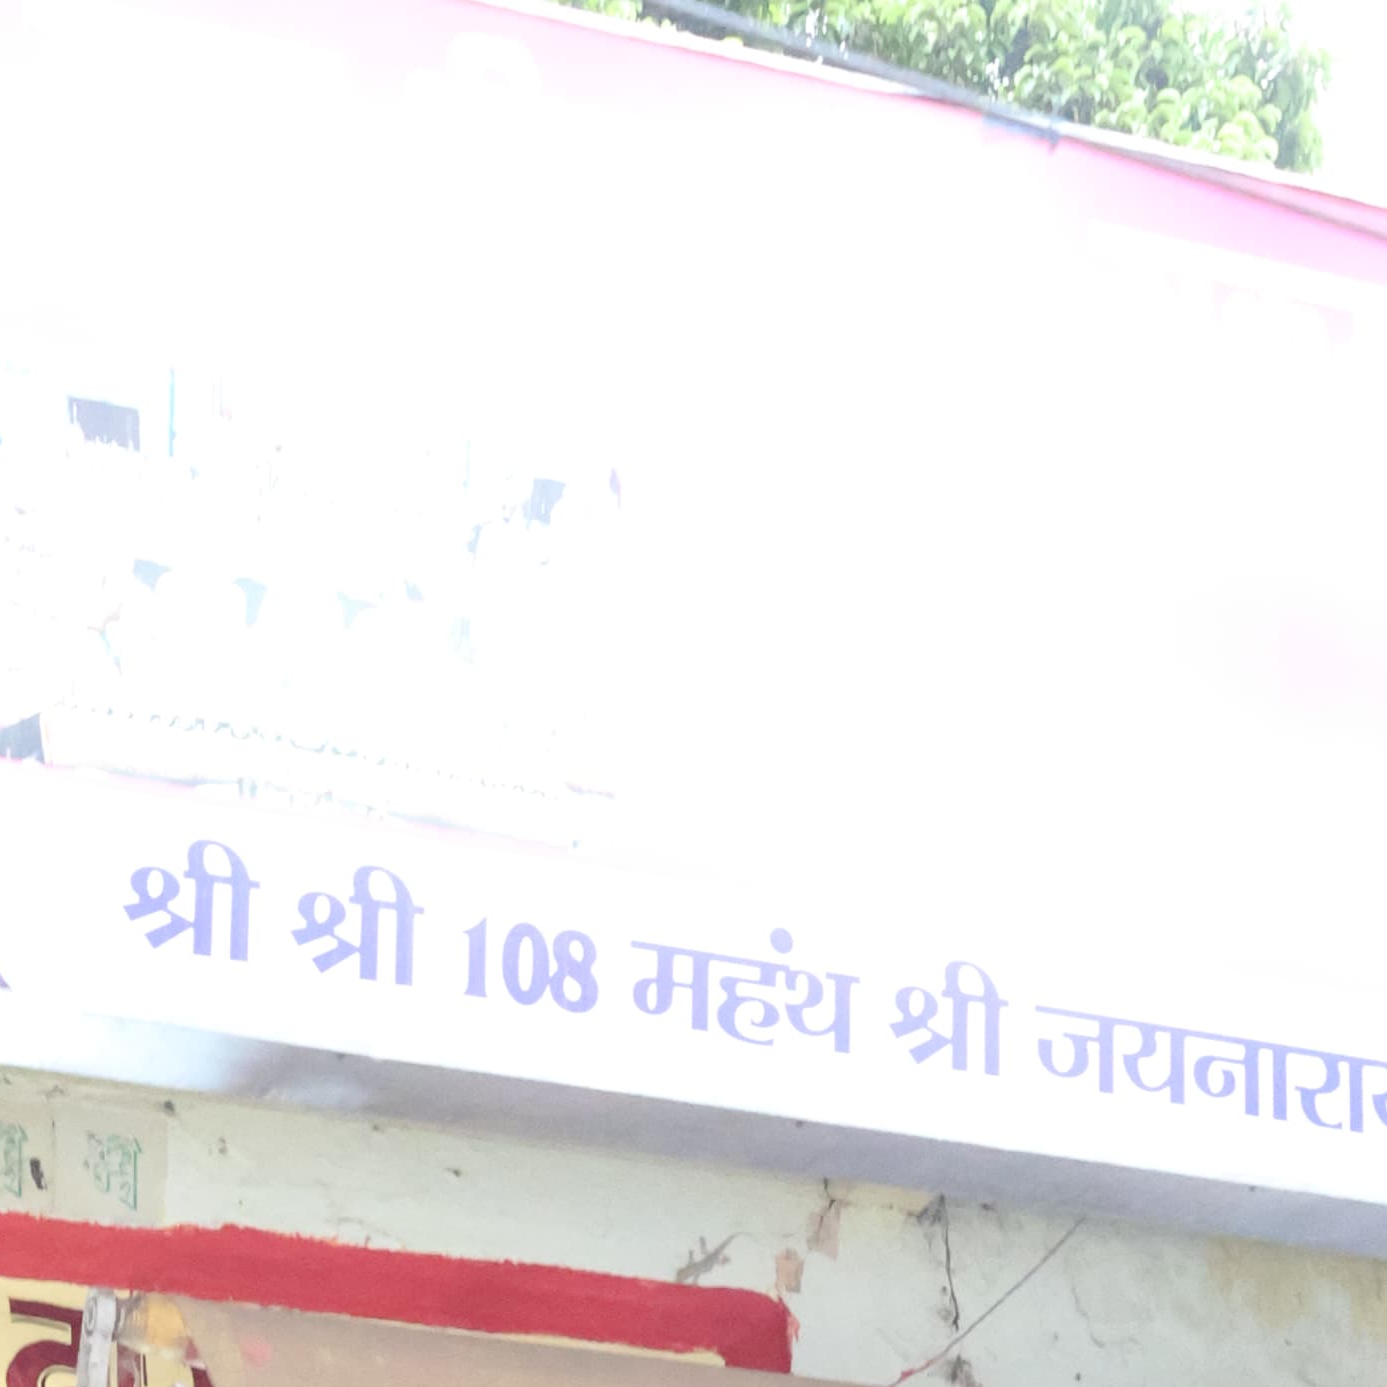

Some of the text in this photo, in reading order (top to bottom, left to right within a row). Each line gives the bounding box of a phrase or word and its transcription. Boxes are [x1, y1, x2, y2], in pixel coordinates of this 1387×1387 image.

[123, 839, 261, 963] श्री
[291, 864, 425, 987] श्री
[462, 914, 600, 1014] 108
[630, 927, 861, 1054] महंथ
[888, 961, 1010, 1078] श्री
